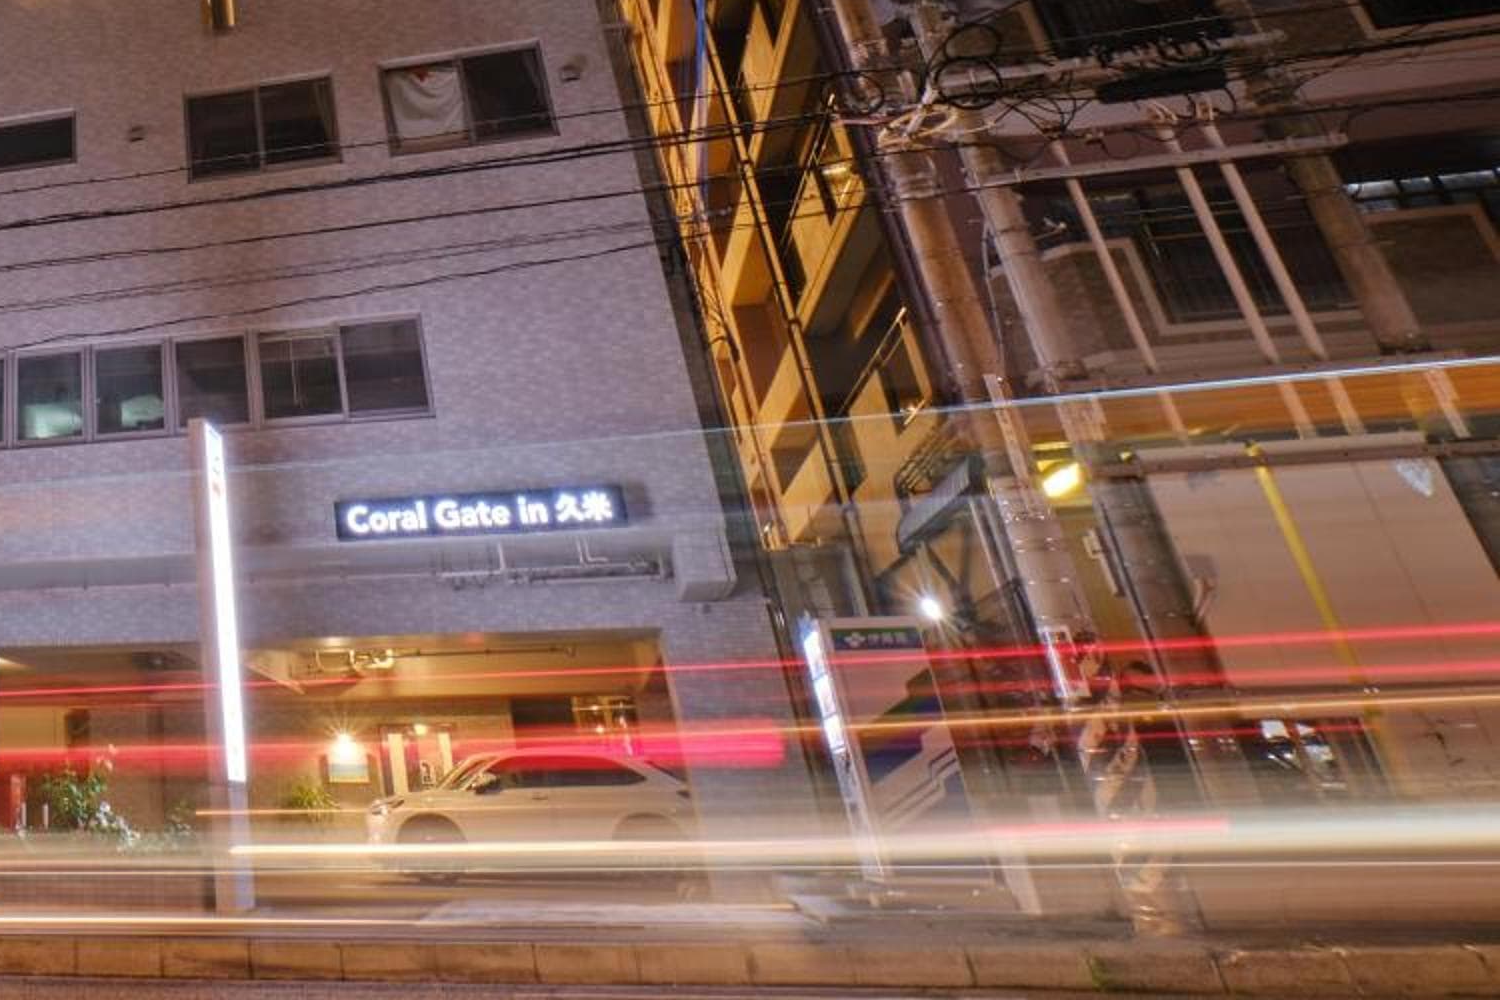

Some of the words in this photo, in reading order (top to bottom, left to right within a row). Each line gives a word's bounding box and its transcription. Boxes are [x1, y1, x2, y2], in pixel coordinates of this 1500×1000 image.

[347, 501, 428, 534] Coral
[434, 498, 510, 529] Gate
[516, 495, 548, 525] in
[556, 491, 613, 522] 久米
